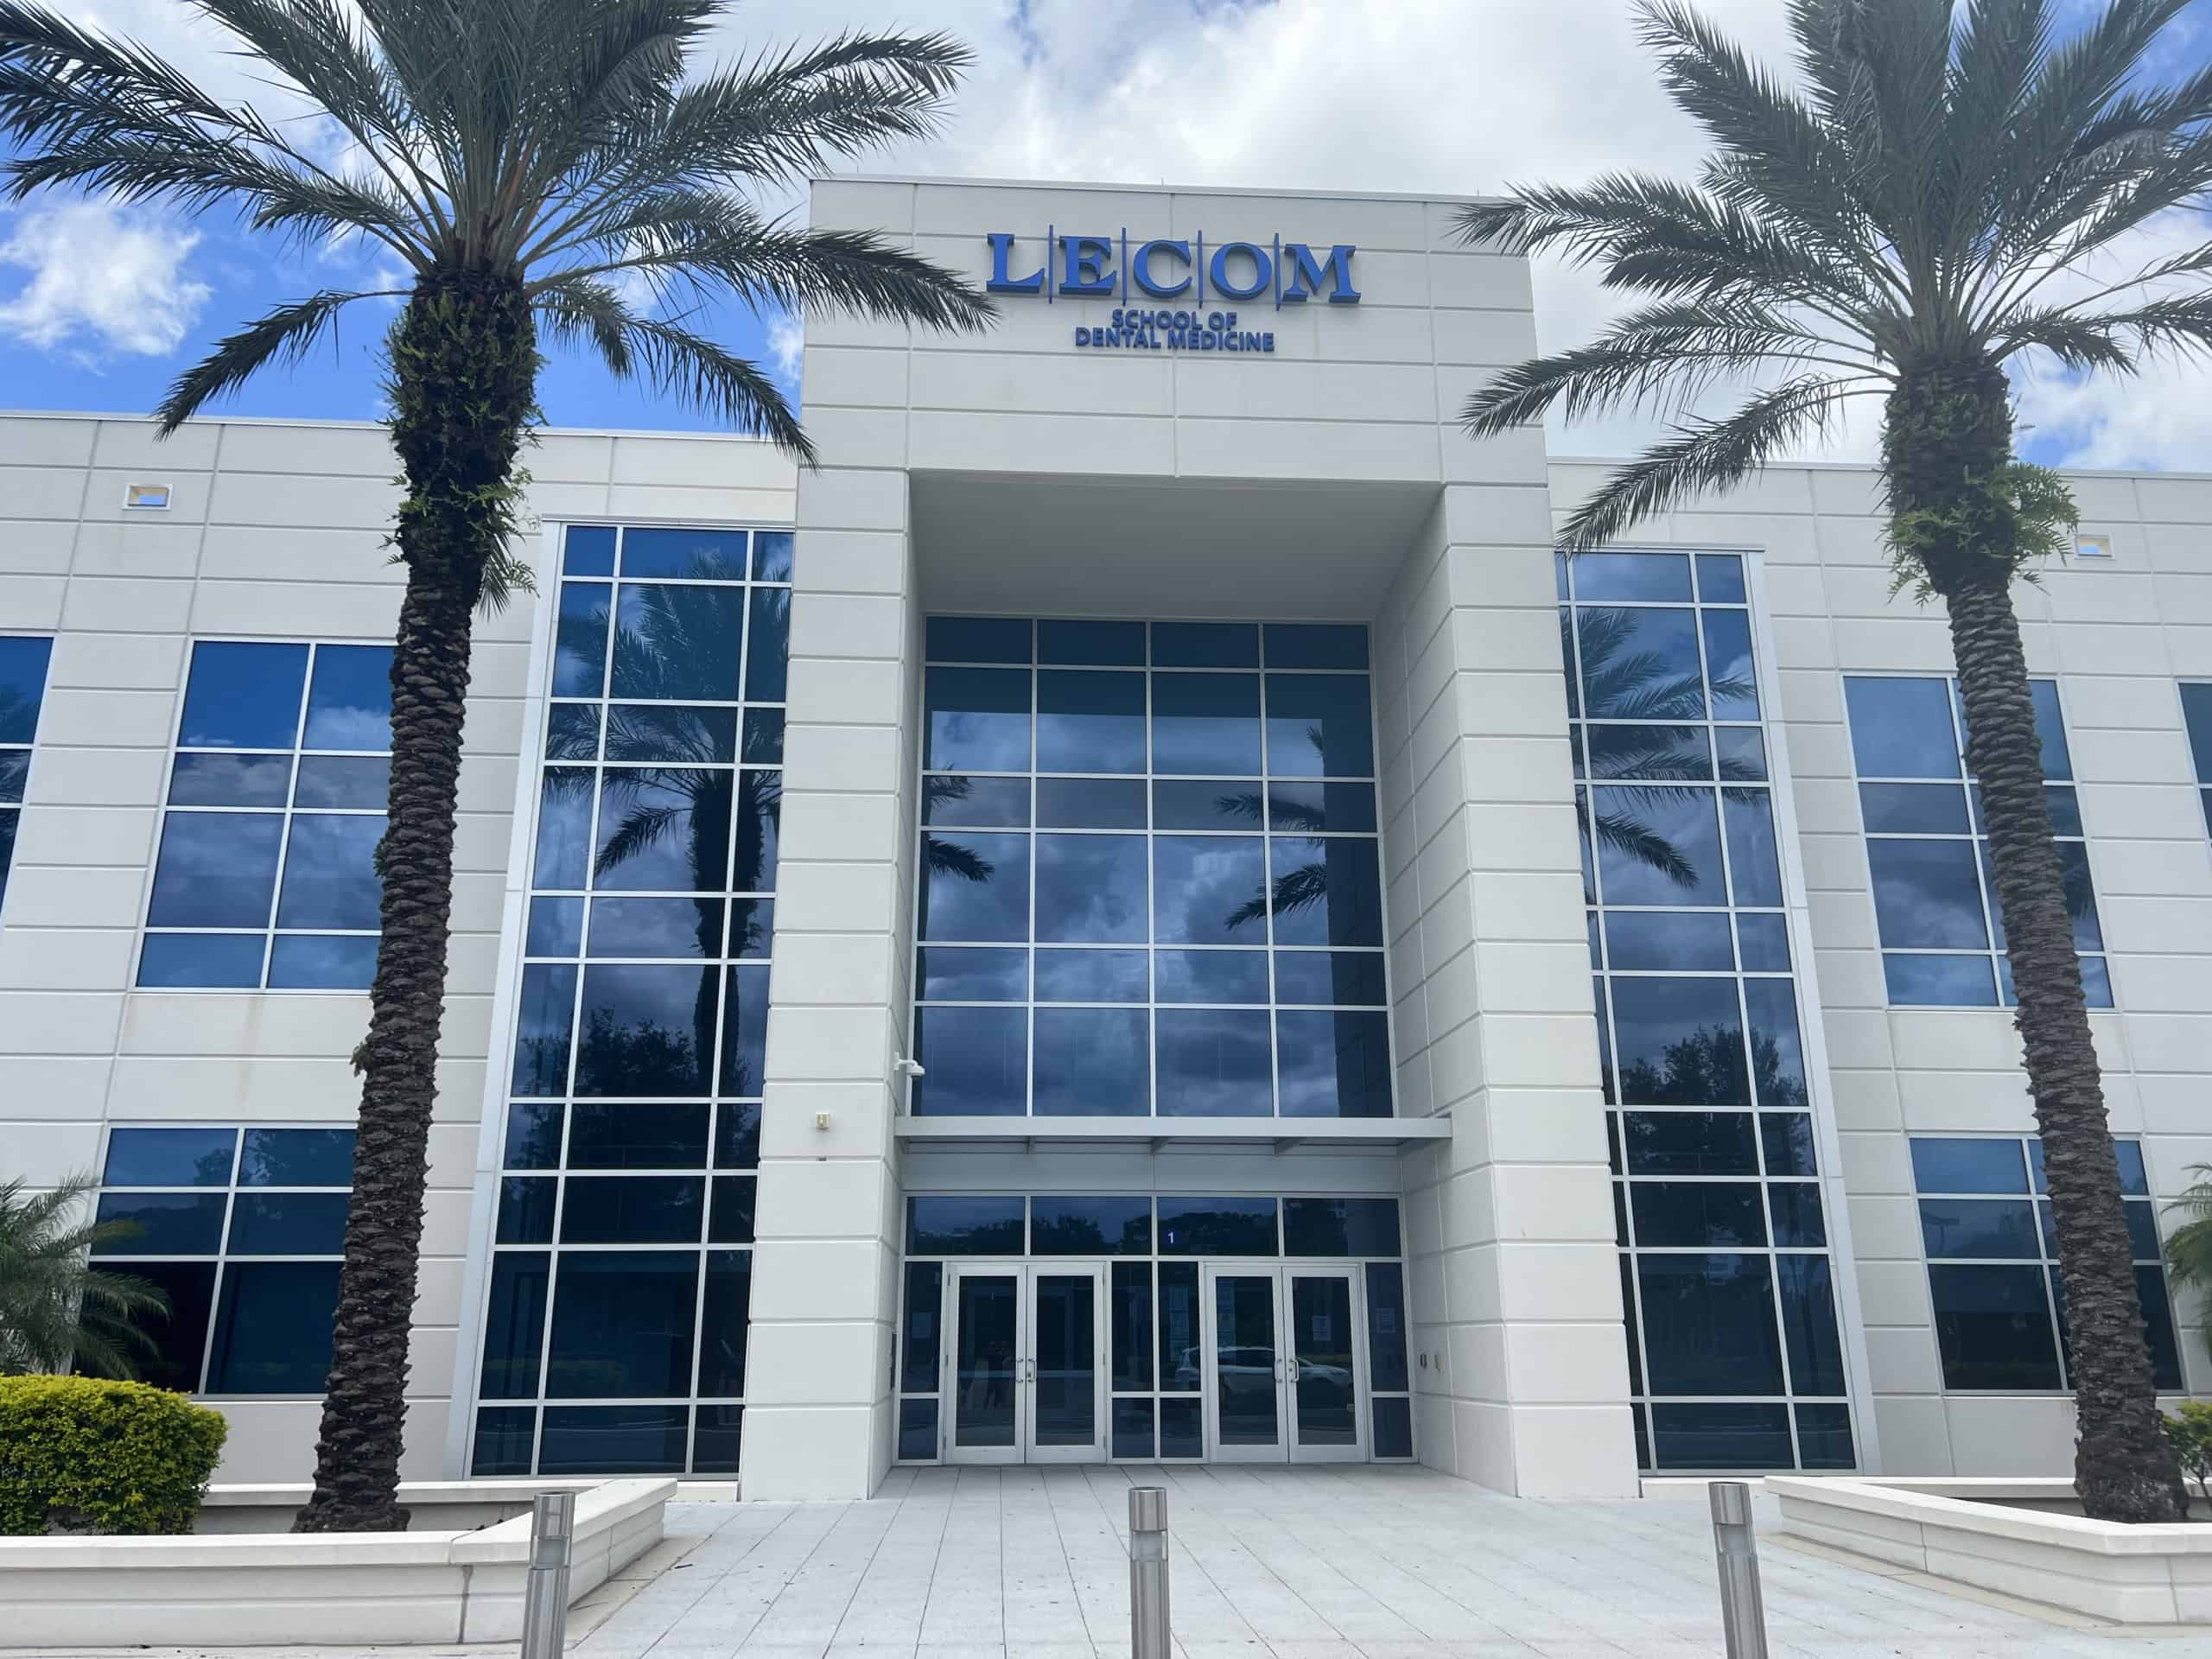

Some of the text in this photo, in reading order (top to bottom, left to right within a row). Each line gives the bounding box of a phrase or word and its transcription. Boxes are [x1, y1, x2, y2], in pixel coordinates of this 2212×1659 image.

[1111, 309, 1238, 331] SCHOOL OF
[1076, 327, 1274, 353] DENTAL MEDICINE
[1167, 1231, 1174, 1243] 1
